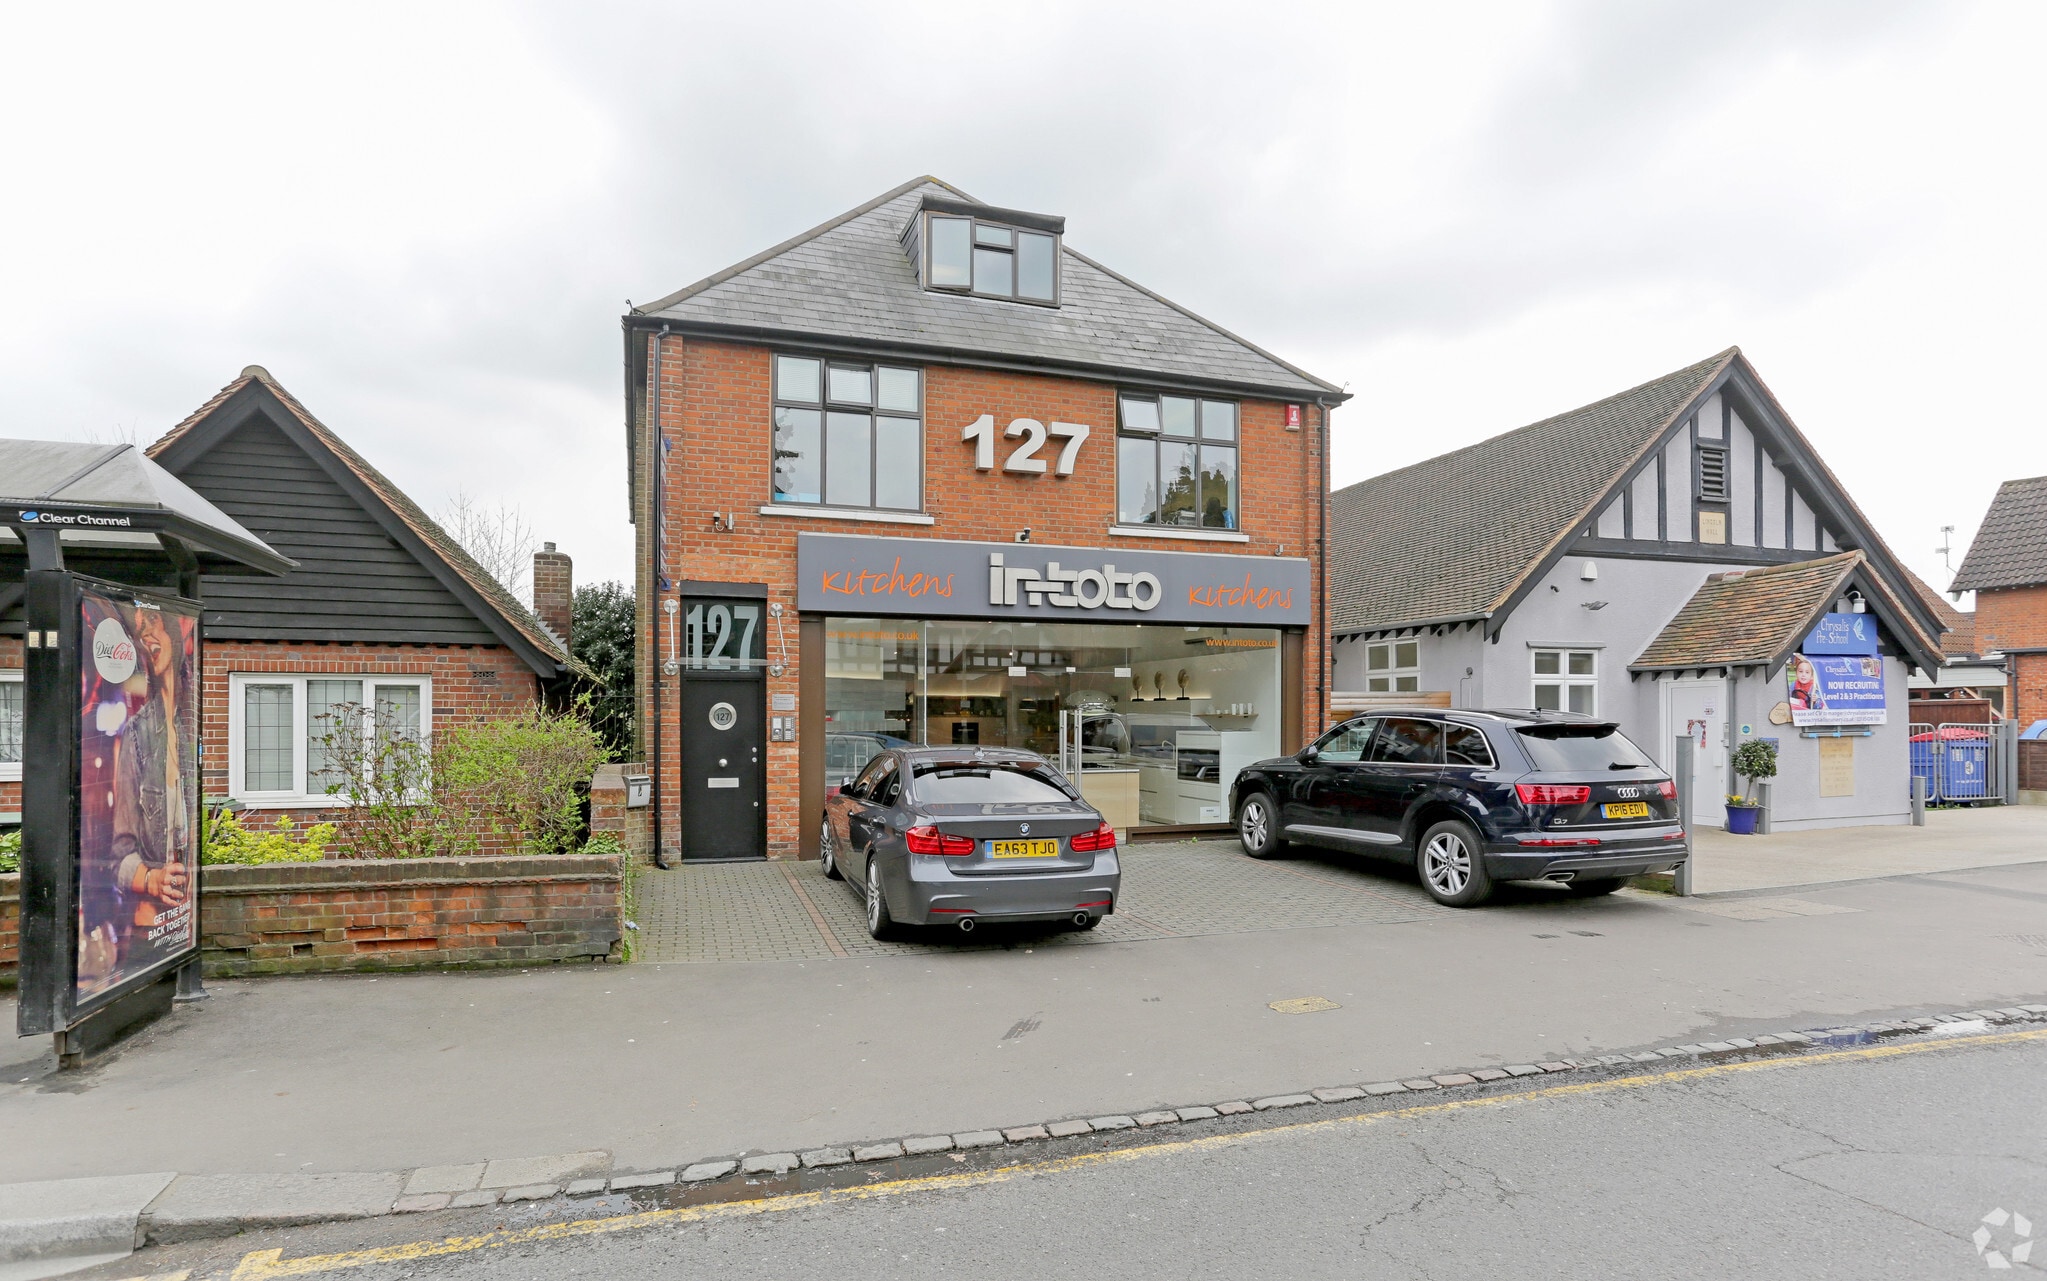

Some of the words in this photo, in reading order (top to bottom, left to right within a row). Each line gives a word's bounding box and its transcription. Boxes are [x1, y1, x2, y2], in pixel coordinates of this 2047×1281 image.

[961, 413, 1090, 477] 127
[40, 513, 75, 524] Clear
[77, 514, 131, 527] Channel
[1820, 617, 1849, 632] Chrysalis
[686, 604, 759, 670] 127
[1816, 629, 1849, 644] Pre-School
[96, 641, 114, 659] Diet
[113, 642, 134, 661] Coke
[1828, 681, 1844, 690] NOW
[1823, 692, 1839, 700] Level
[716, 712, 730, 721] 127
[1608, 804, 1628, 816] KP16
[1629, 803, 1644, 815] EDV
[994, 842, 1028, 856] EA63
[1031, 841, 1055, 855] TJO
[153, 912, 166, 925] GET
[167, 907, 179, 920] THE
[179, 900, 191, 914] GANG
[148, 925, 165, 941] BACK
[166, 912, 190, 932] TOGETHER
